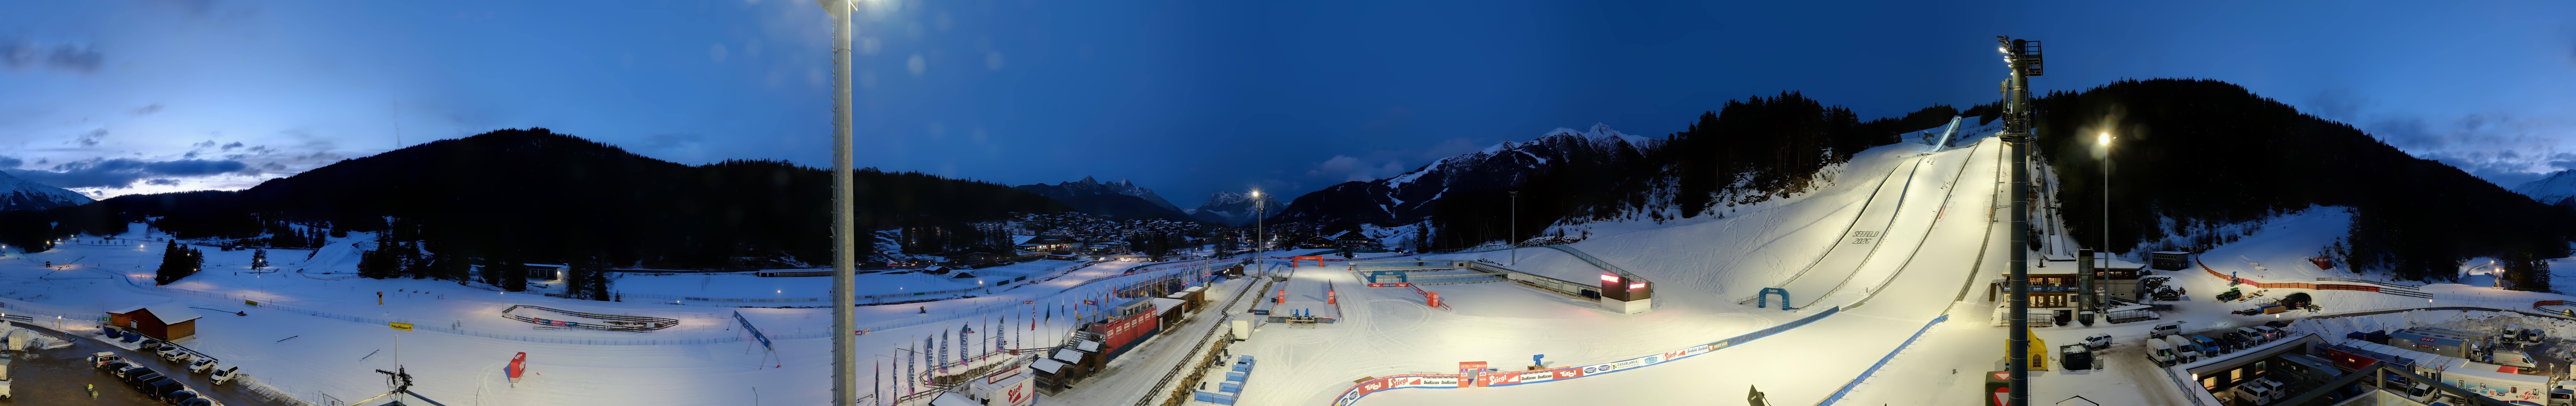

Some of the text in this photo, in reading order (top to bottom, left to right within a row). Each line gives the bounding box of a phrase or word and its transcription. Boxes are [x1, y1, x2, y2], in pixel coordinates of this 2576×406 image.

[1665, 351, 1676, 361] Stiegl
[1391, 377, 1408, 388] Stiegl
[1489, 375, 1506, 385] Stiegl
[1365, 382, 1381, 391] Tirol
[1008, 382, 1022, 403] Stiegl
